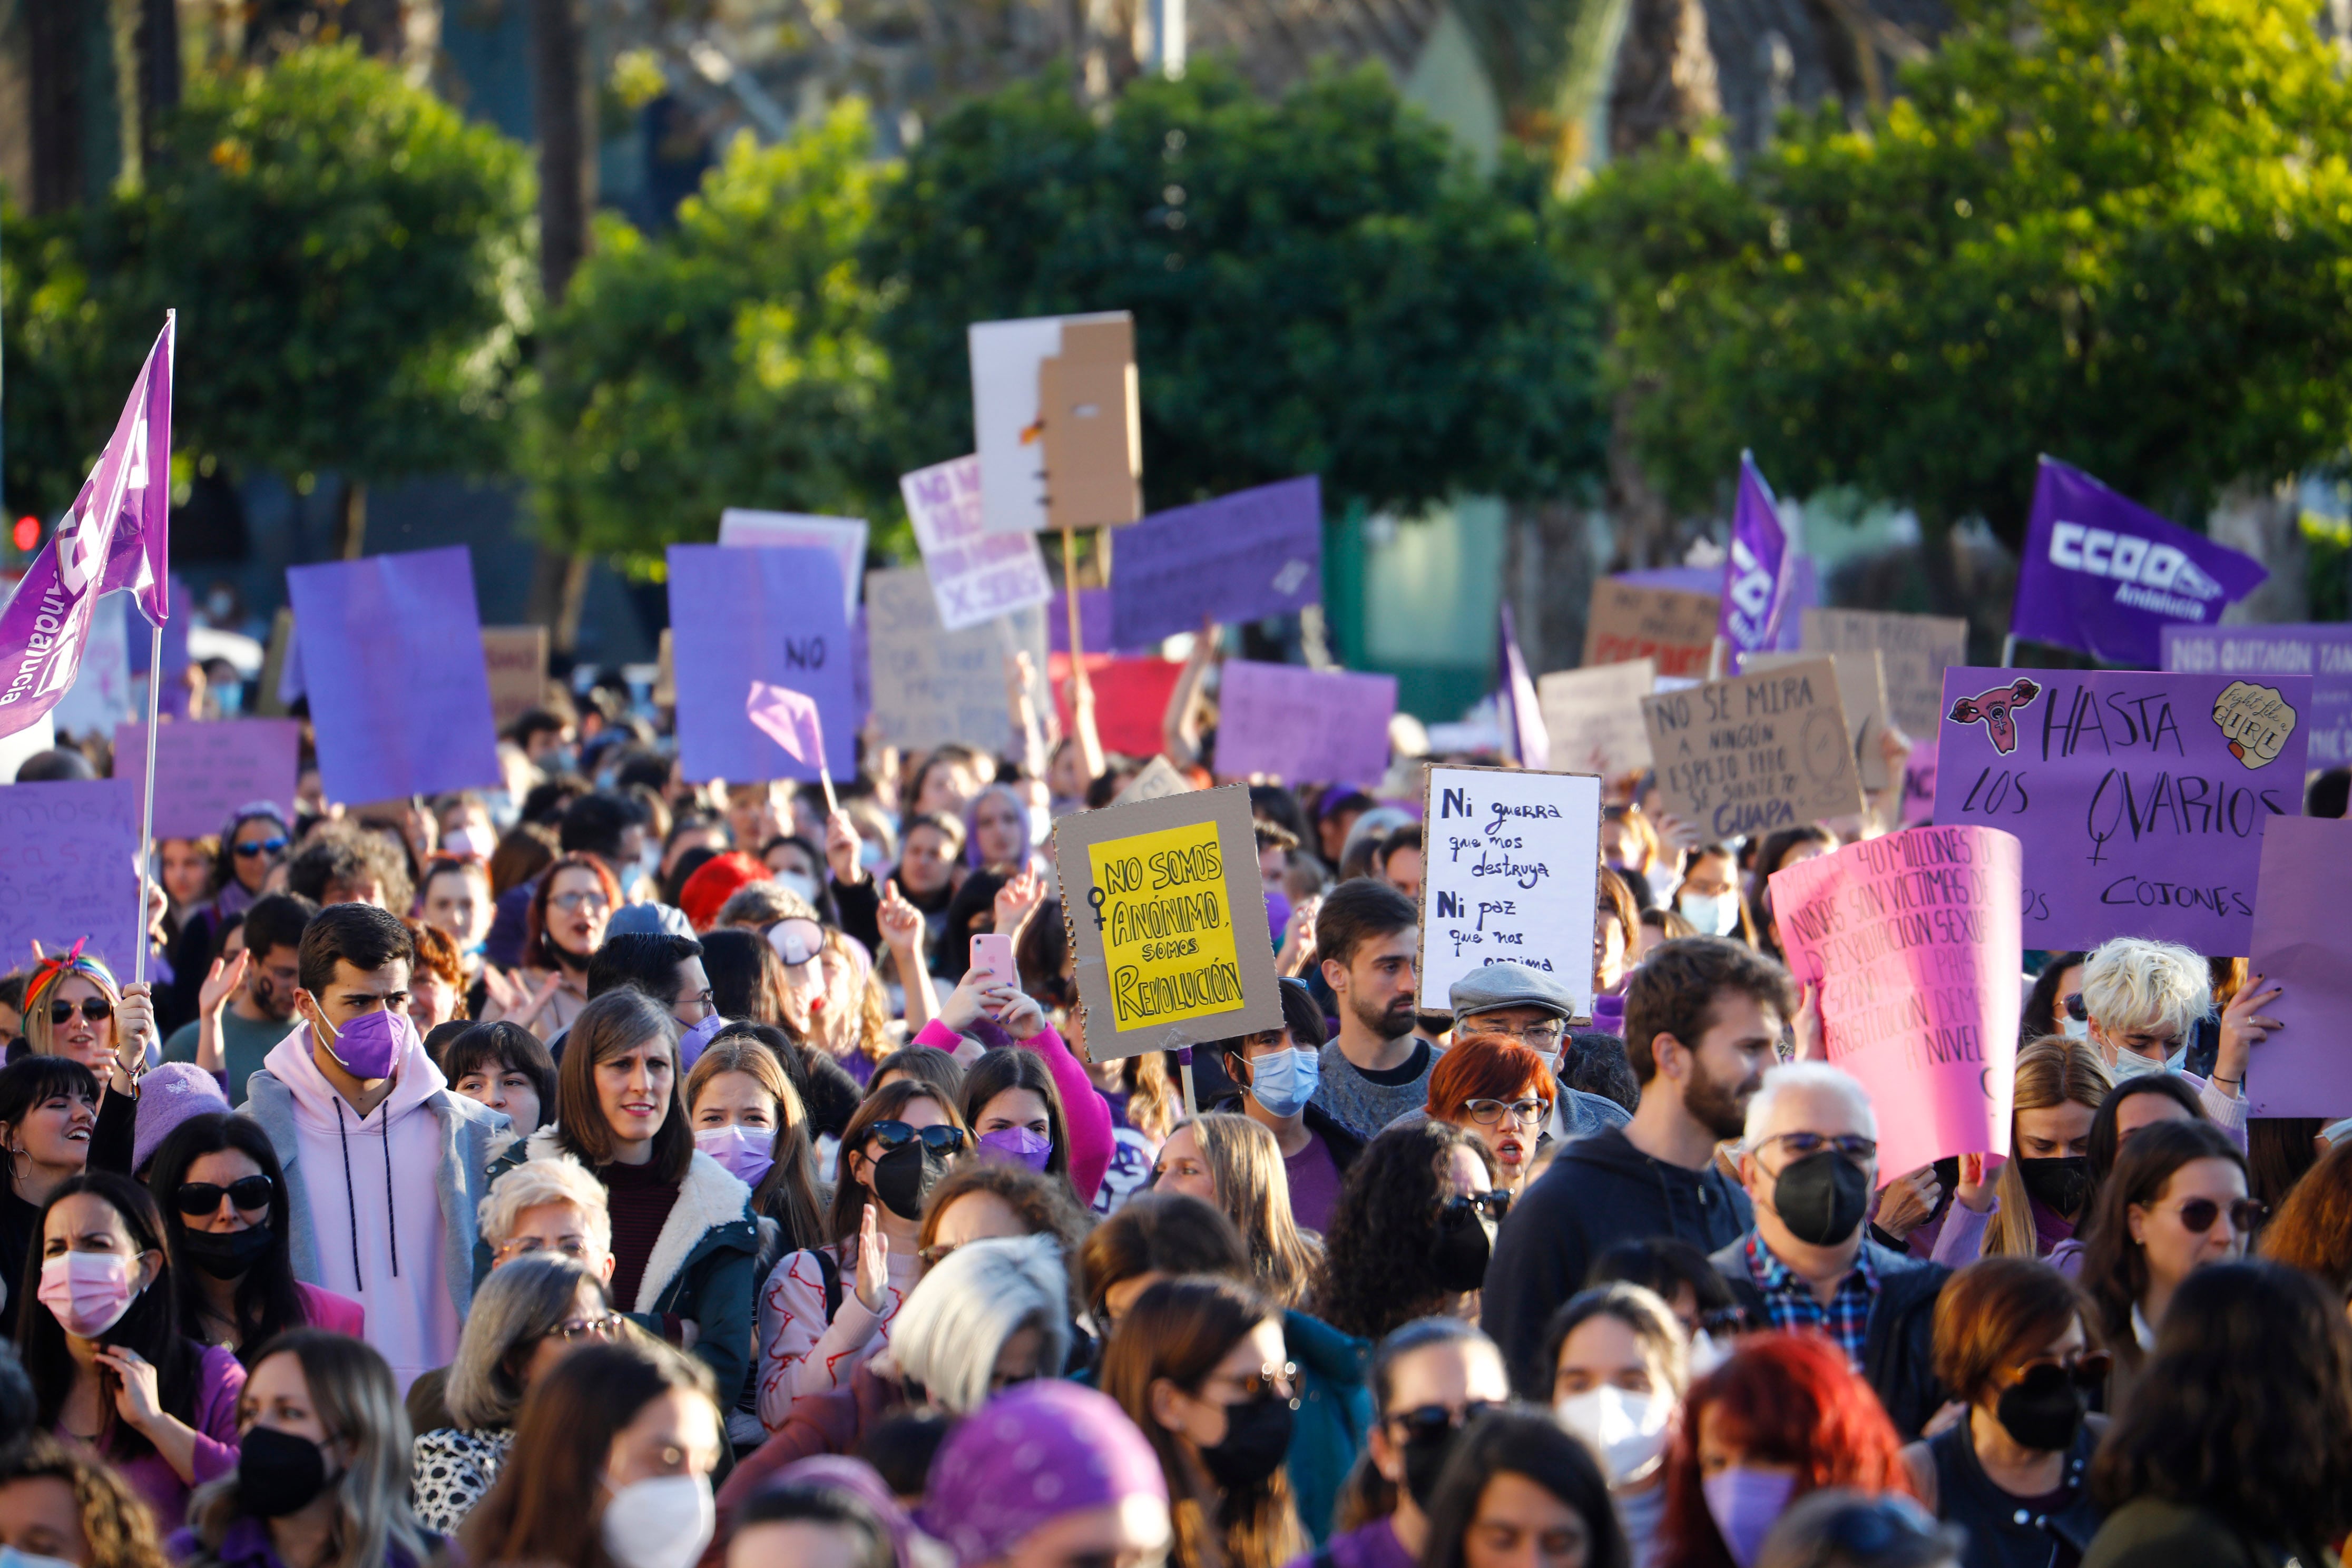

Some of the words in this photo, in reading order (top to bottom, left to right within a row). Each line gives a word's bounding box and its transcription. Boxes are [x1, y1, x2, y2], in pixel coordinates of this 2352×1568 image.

[2049, 519, 2188, 591] CCOO
[786, 637, 826, 669] NO
[1703, 685, 1730, 722] SE
[1746, 677, 1814, 716] MIRA
[2042, 685, 2184, 762] HASTA
[2212, 705, 2278, 751] GIRL
[1679, 738, 1692, 756] A
[1668, 754, 1738, 793] ESPEJO
[1962, 767, 2028, 815] LOS
[1440, 788, 1473, 819] Ni
[1104, 856, 1143, 896] NO
[1148, 841, 1223, 890] SOMOS
[1449, 836, 1482, 863] que
[1489, 835, 1523, 849] nos
[1856, 841, 1885, 876] 40
[1886, 828, 1972, 871] MILLONES
[1436, 890, 1465, 918] Ni
[1476, 900, 1517, 932] paz
[1788, 896, 1845, 946] NIÑAS
[1848, 880, 1885, 923] SON
[2022, 888, 2050, 921] OS
[2099, 875, 2255, 918] COJONES
[1141, 937, 1200, 962] SOMOS
[1448, 928, 1484, 957] que
[1492, 930, 1524, 946] nos
[1114, 957, 1243, 1022] REVOLUCIÓN
[1924, 1024, 1986, 1065] NIVEL
